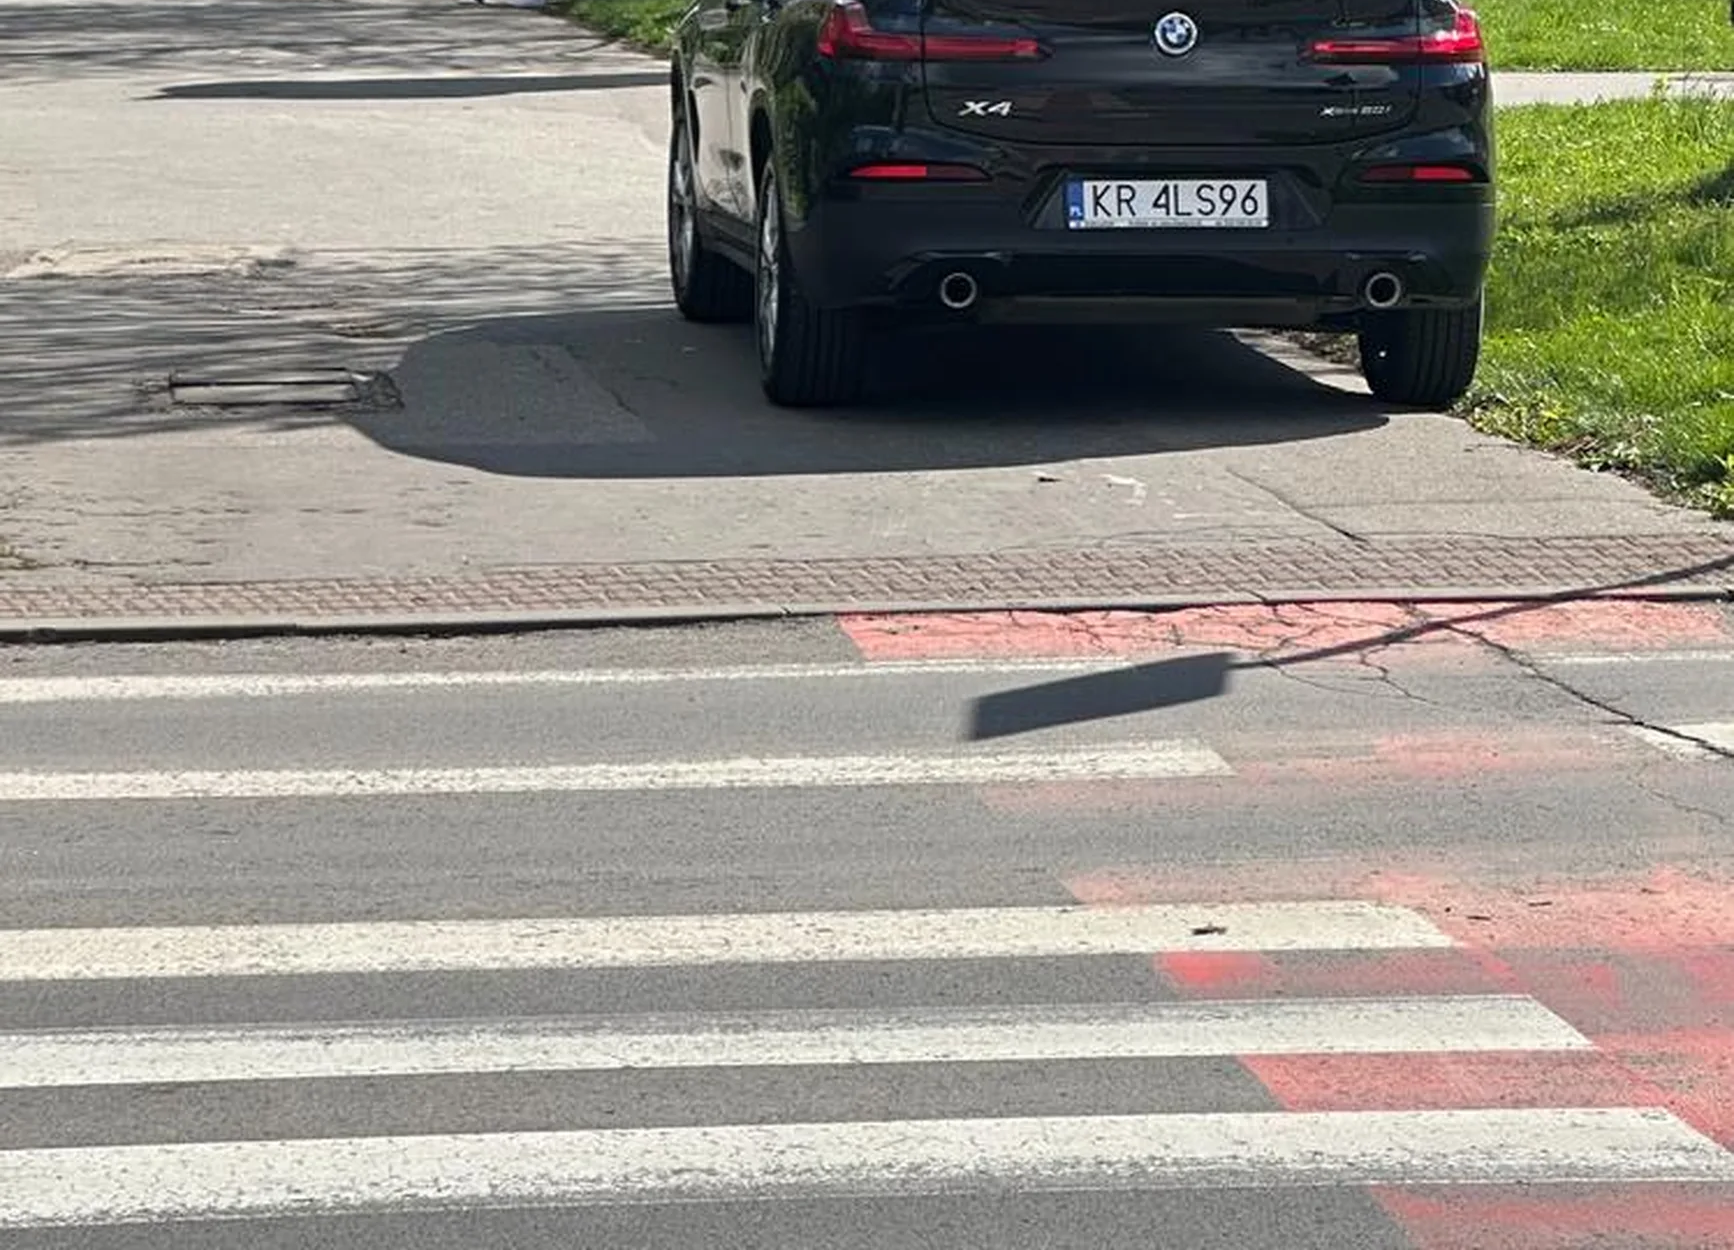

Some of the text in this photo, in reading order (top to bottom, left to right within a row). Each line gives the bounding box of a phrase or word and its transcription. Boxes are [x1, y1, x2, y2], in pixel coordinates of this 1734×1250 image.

[959, 101, 1012, 116] X4
[1092, 184, 1259, 217] KR 4LS96
